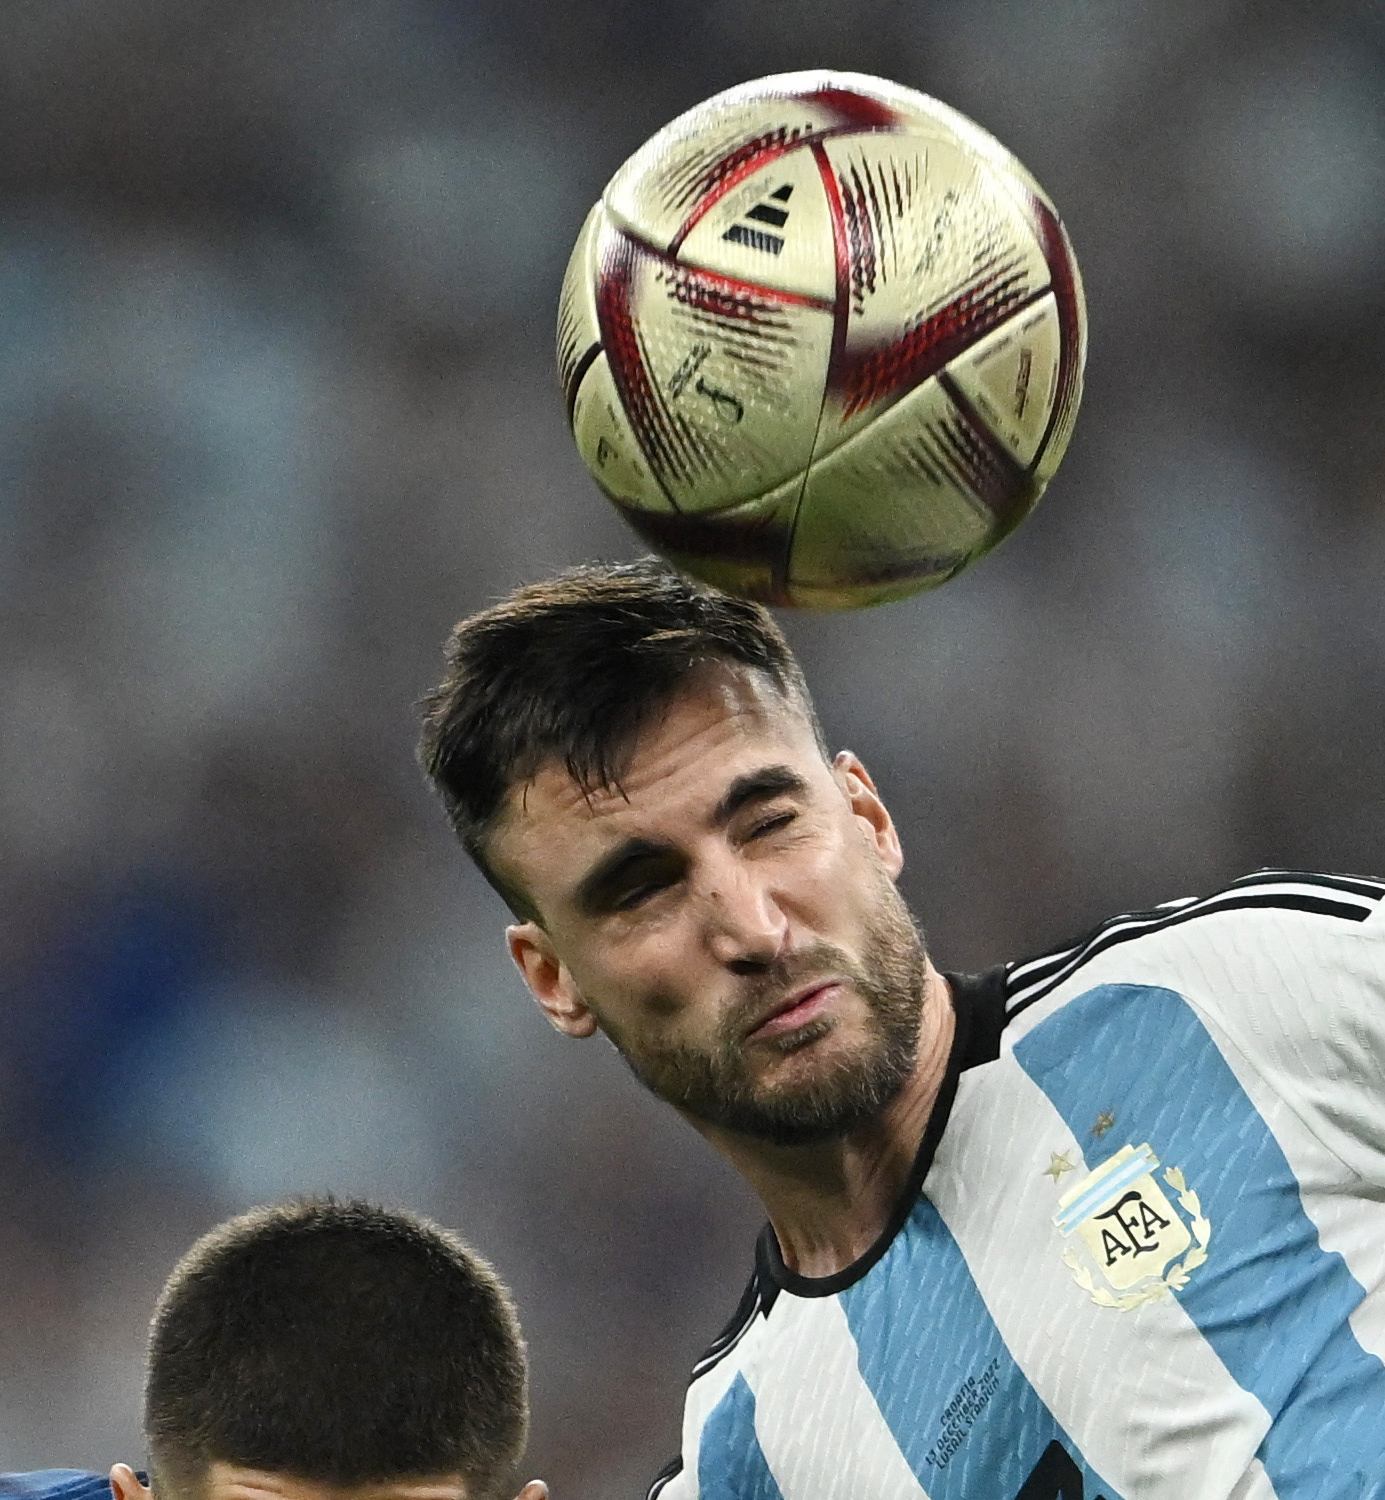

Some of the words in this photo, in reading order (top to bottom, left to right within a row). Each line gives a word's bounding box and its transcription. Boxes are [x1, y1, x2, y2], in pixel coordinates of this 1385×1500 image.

[1092, 1190, 1171, 1267] AFA
[935, 1429, 967, 1470] LUSAIL
[965, 1377, 1000, 1427] STADIUM
[936, 1389, 978, 1451] DECEMBER
[940, 1376, 975, 1426] CROATIA
